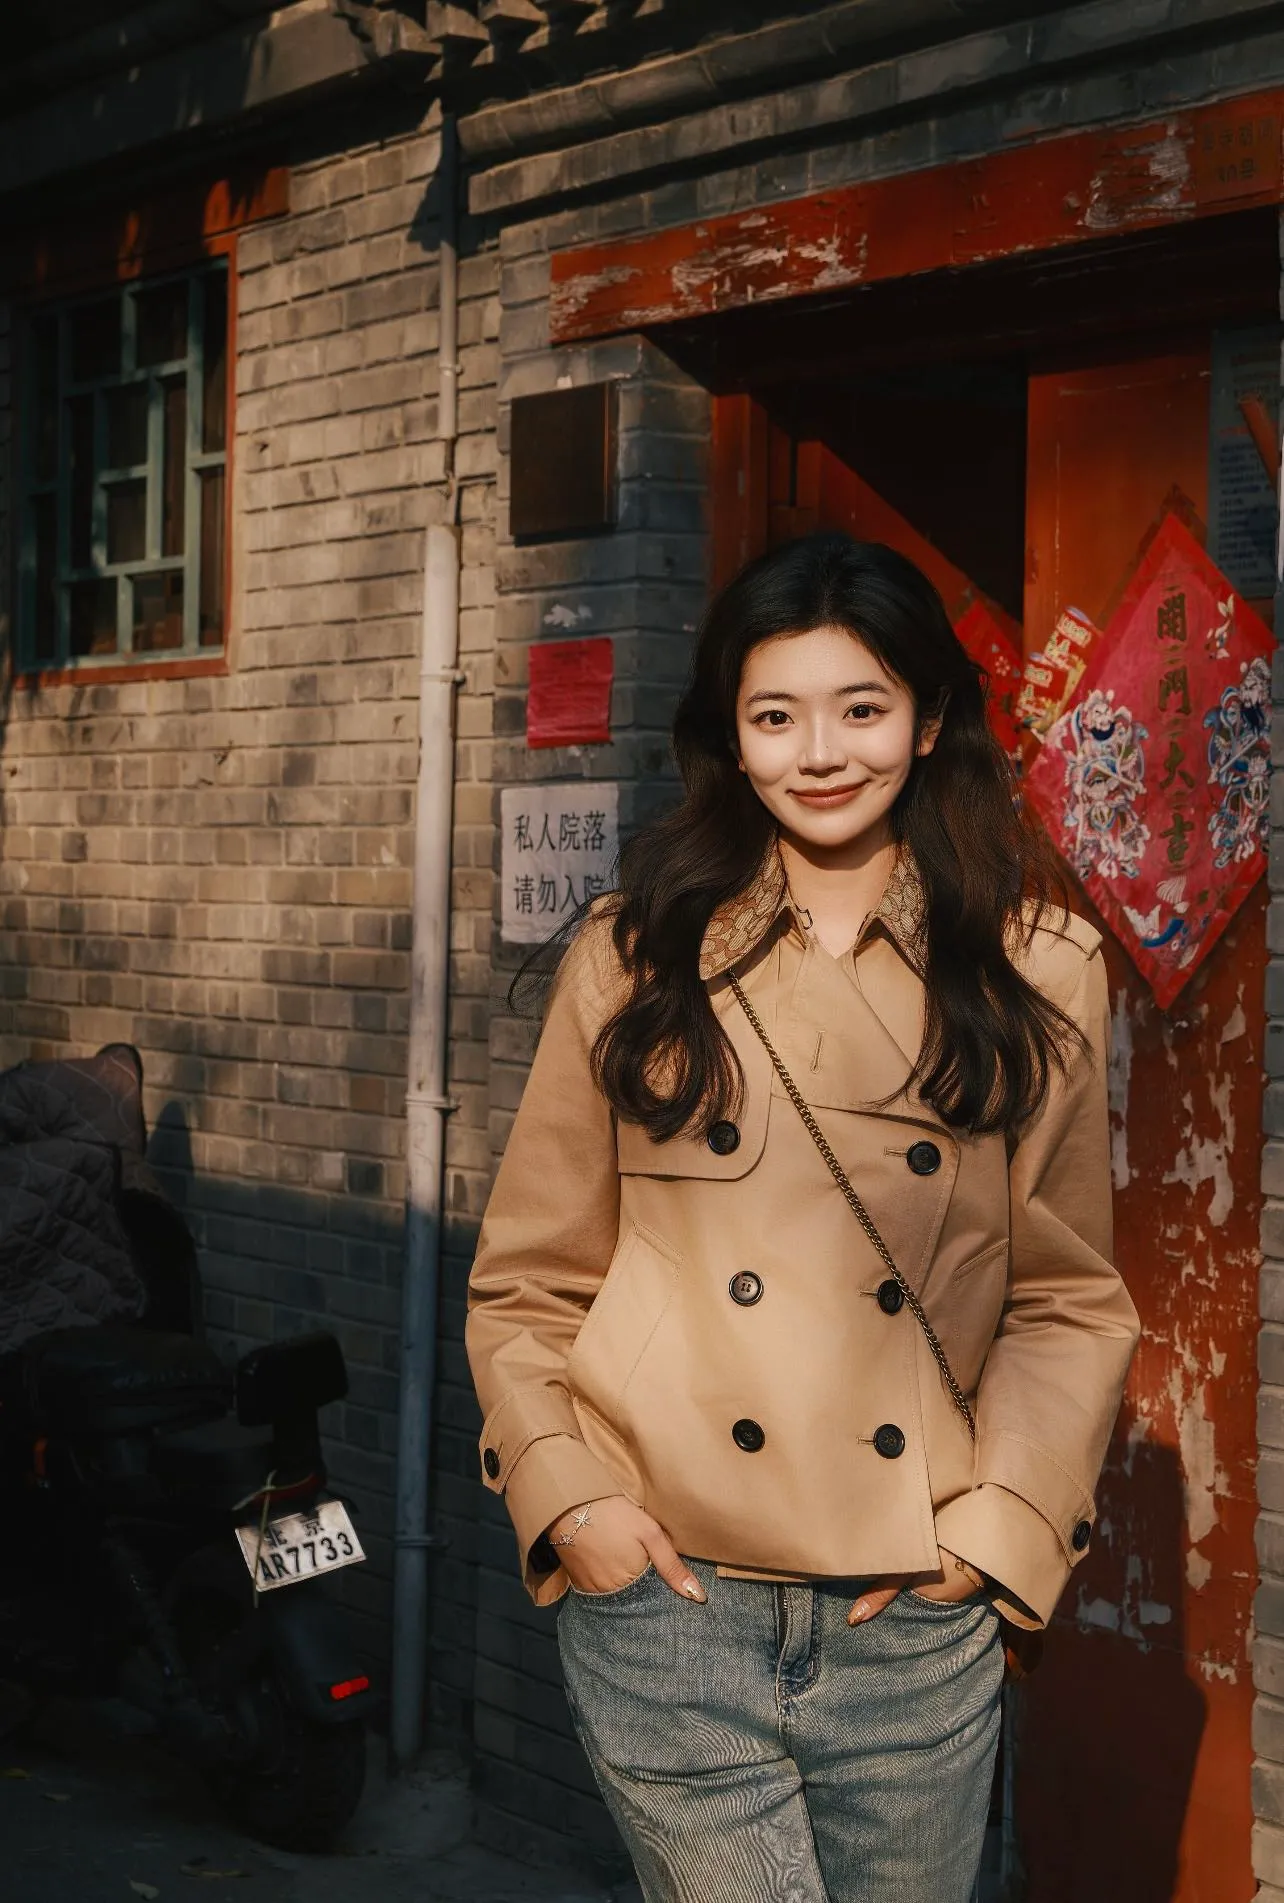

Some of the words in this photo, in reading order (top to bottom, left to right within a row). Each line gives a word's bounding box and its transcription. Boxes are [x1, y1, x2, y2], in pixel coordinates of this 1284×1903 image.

[513, 809, 607, 853] 私人院落
[258, 1532, 354, 1581] AR7733
